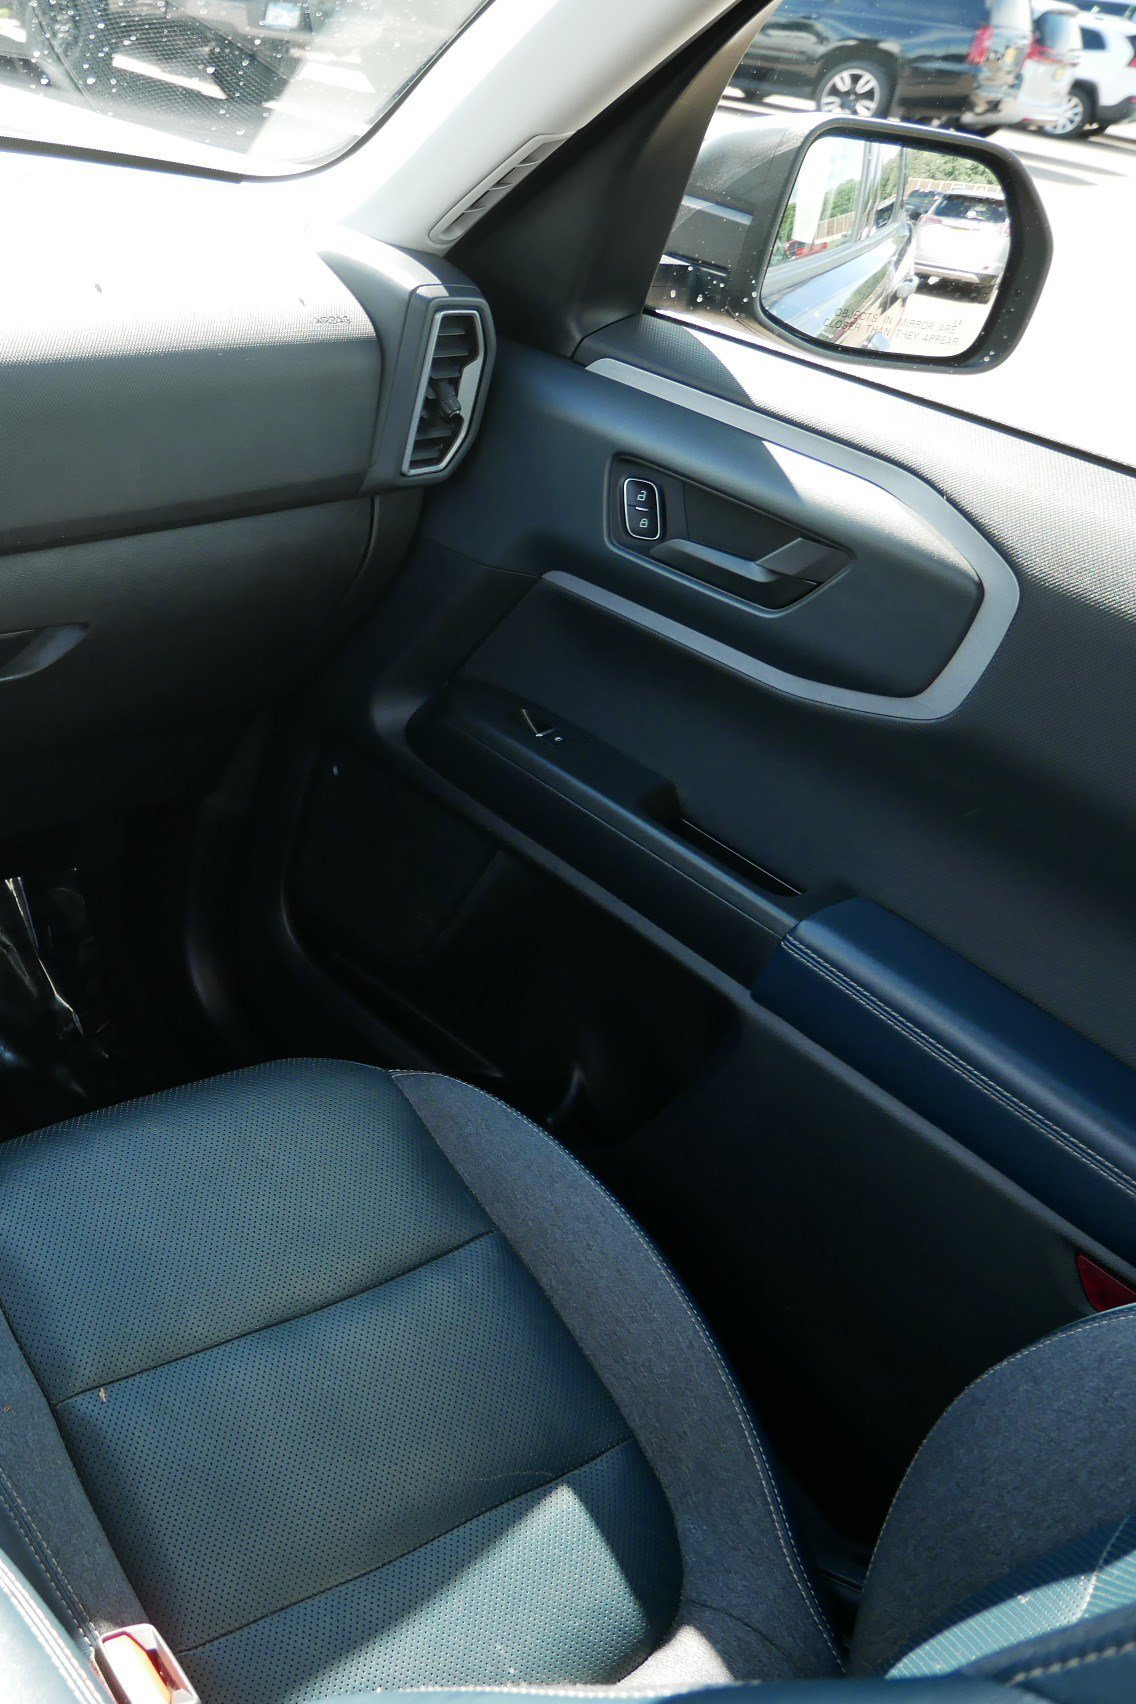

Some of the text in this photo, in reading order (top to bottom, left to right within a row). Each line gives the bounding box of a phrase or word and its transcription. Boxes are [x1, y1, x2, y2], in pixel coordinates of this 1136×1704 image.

[823, 318, 960, 346] CLOSER THAN THEY APPEAR
[835, 308, 958, 335] OBJECTS IN MIRROR ARE
